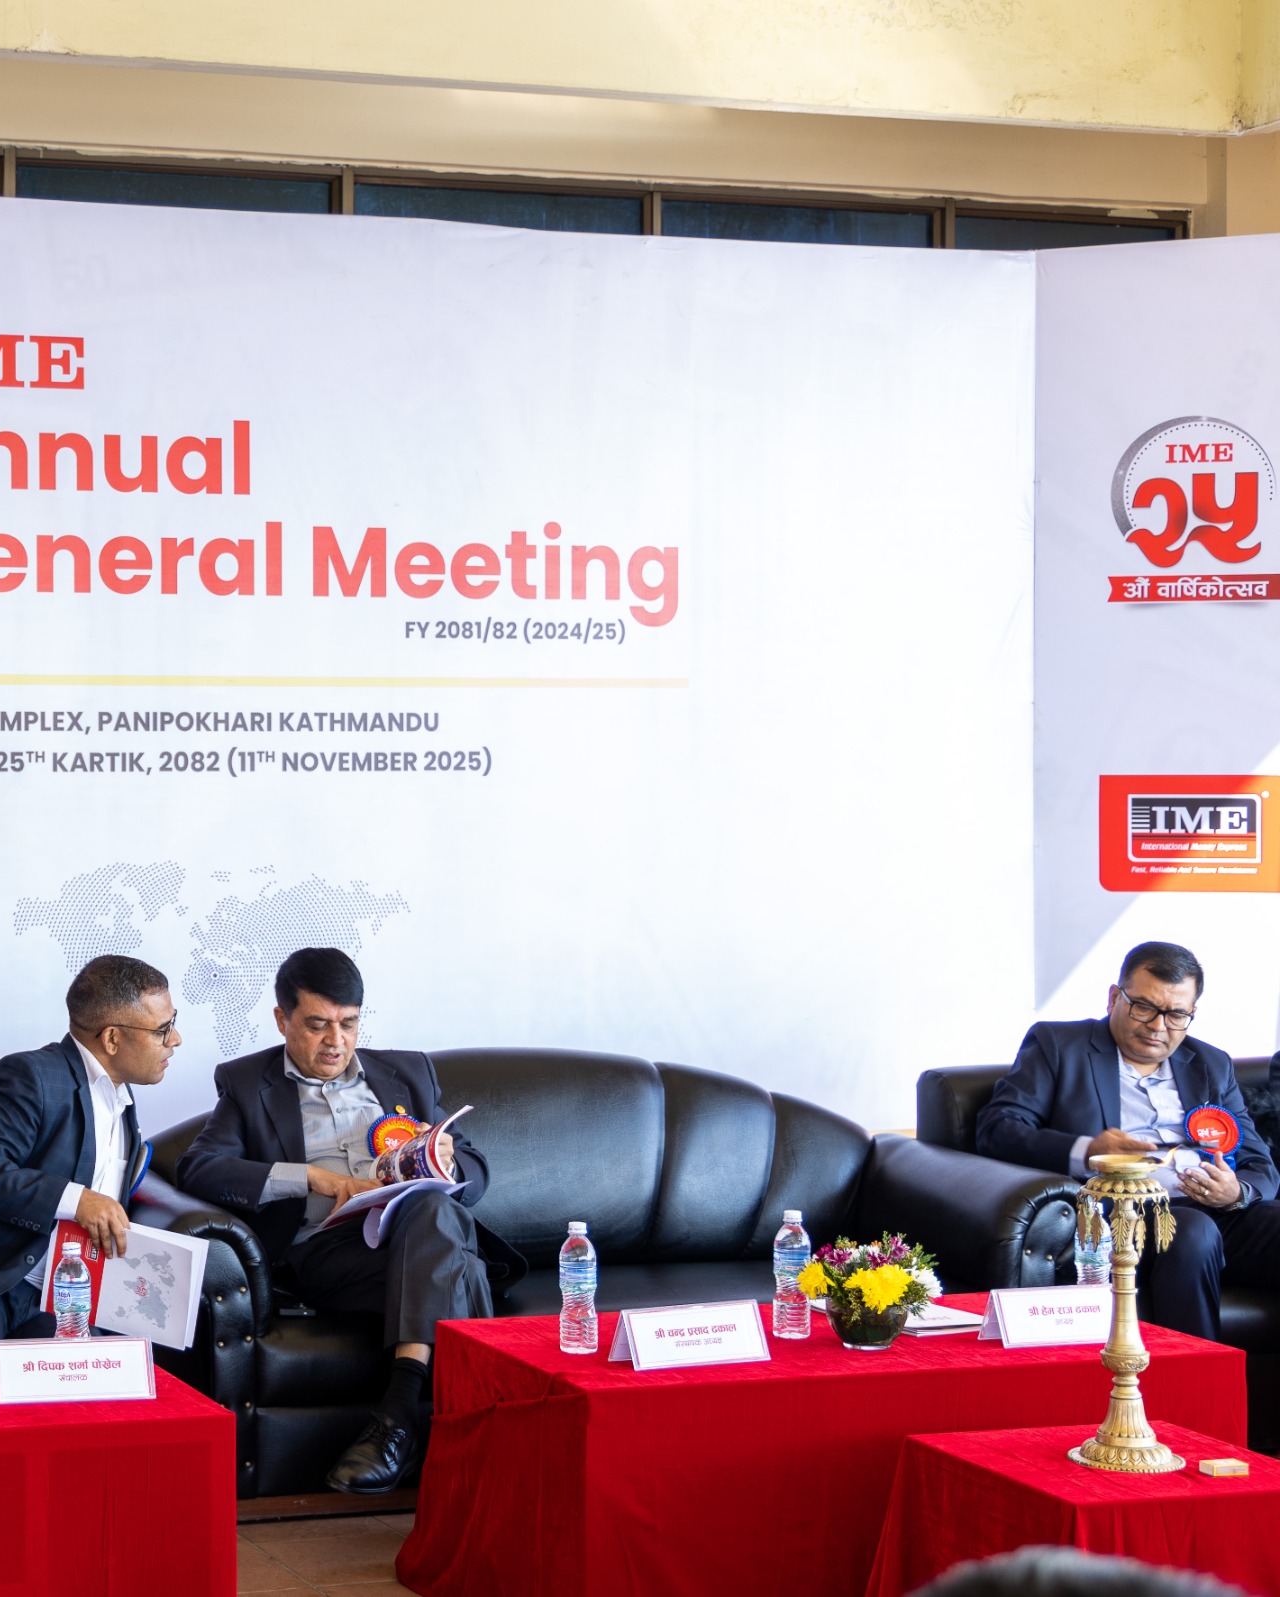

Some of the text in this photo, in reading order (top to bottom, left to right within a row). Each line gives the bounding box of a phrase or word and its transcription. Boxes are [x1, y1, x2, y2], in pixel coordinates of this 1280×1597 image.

[1165, 443, 1234, 464] IME
[1126, 471, 1262, 568] २५
[313, 521, 680, 630] Meeting
[1157, 576, 1269, 598] वार्षिकोत्सव
[406, 617, 626, 645] FY 2081/82 (2024/25)
[99, 711, 272, 732] PANIPOKHARI
[279, 712, 439, 732] KATHMANDU
[52, 752, 152, 776] KARTIK,
[160, 752, 220, 773] 2082
[281, 751, 418, 772] NOVEMBER
[423, 747, 492, 777] 2025)
[1151, 806, 1248, 834] IME
[1028, 1306, 1039, 1316] श्री
[1041, 1305, 1055, 1316] हेम
[1057, 1306, 1073, 1314] राज
[655, 1328, 665, 1339] श्री
[687, 1326, 709, 1336] प्रसाद
[22, 1361, 35, 1372] श्री
[38, 1360, 65, 1371] दिपक
[68, 1359, 88, 1370] शर्मा
